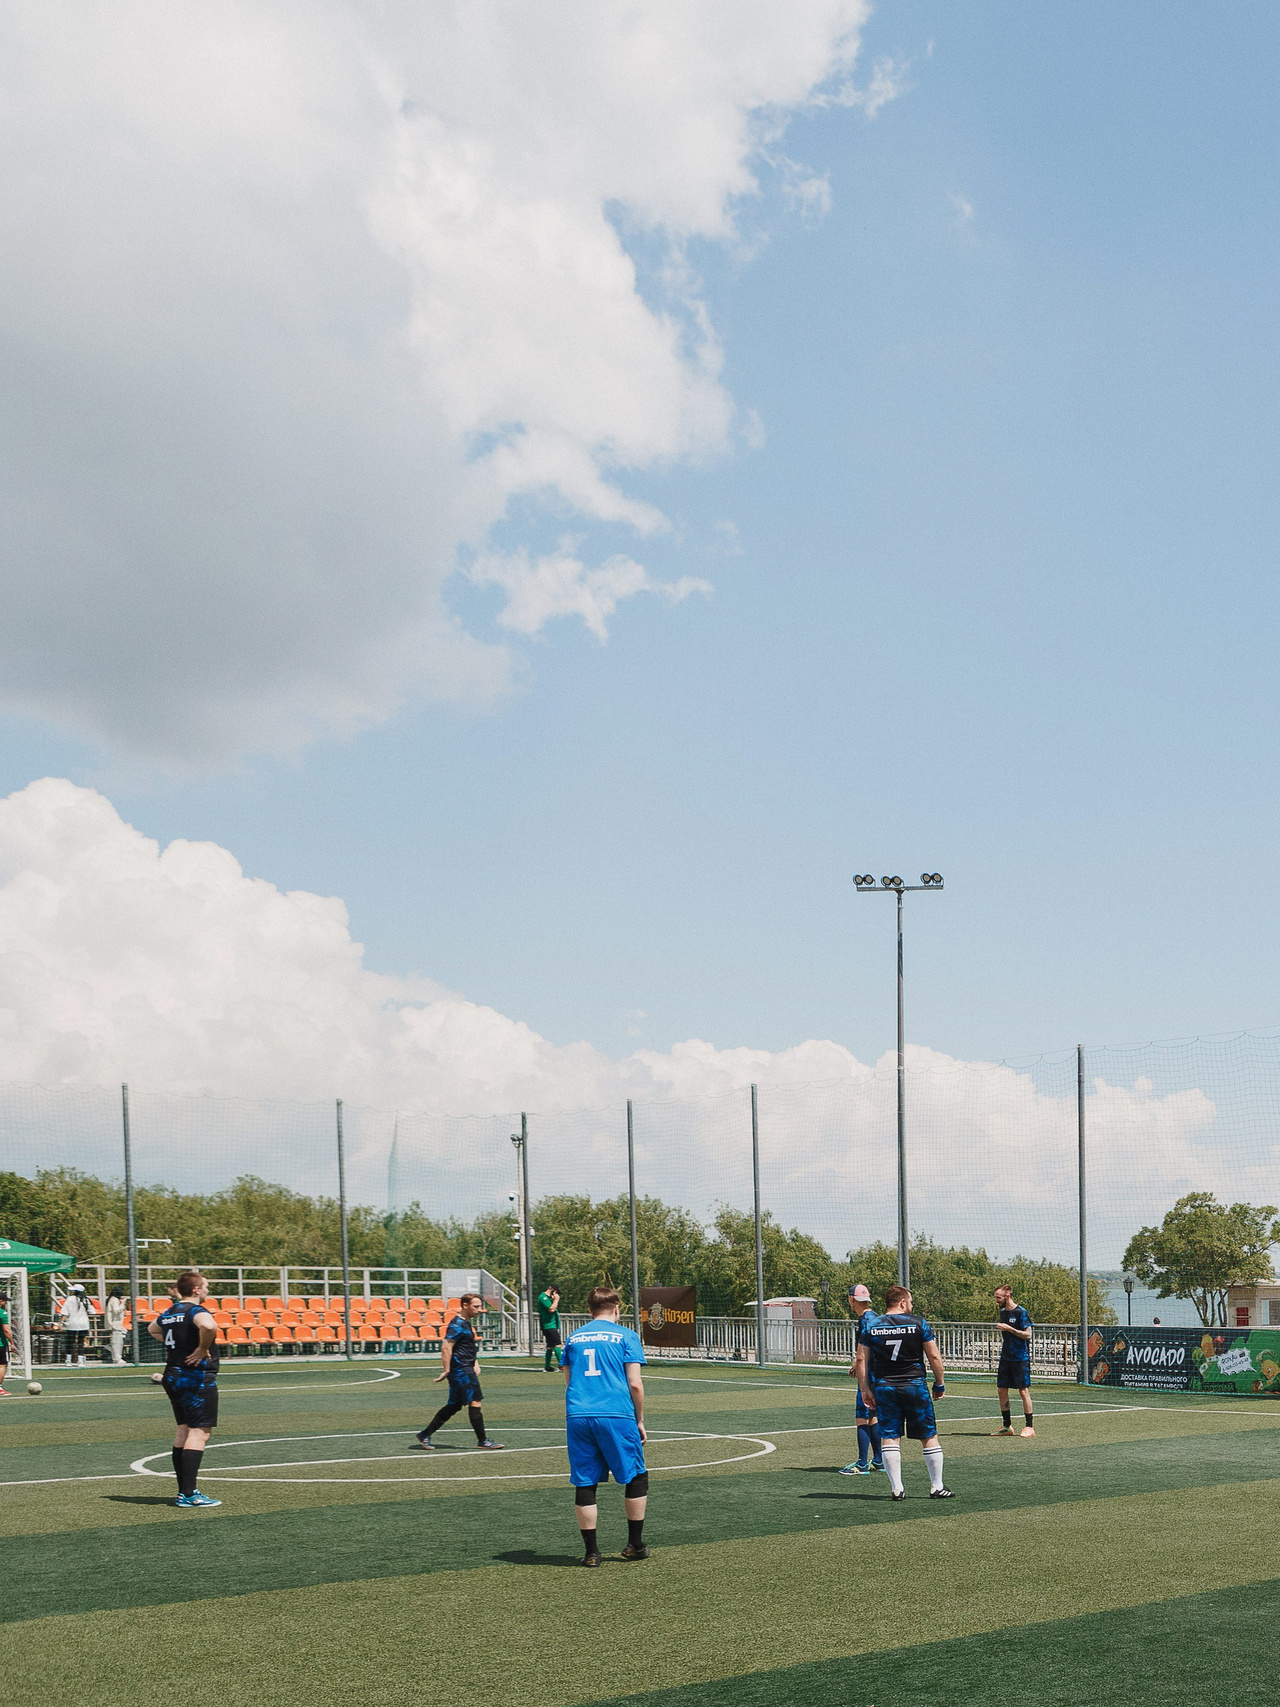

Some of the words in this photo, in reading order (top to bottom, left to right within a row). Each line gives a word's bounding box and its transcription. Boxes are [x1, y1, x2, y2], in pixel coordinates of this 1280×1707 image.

[164, 1328, 176, 1349] 4
[871, 1327, 906, 1335] Umbrella
[907, 1326, 917, 1334] IT
[885, 1339, 903, 1362] 7
[1126, 1345, 1185, 1367] AVOCADO
[583, 1348, 601, 1377] 1
[1120, 1373, 1148, 1381] ДОСТАВКА
